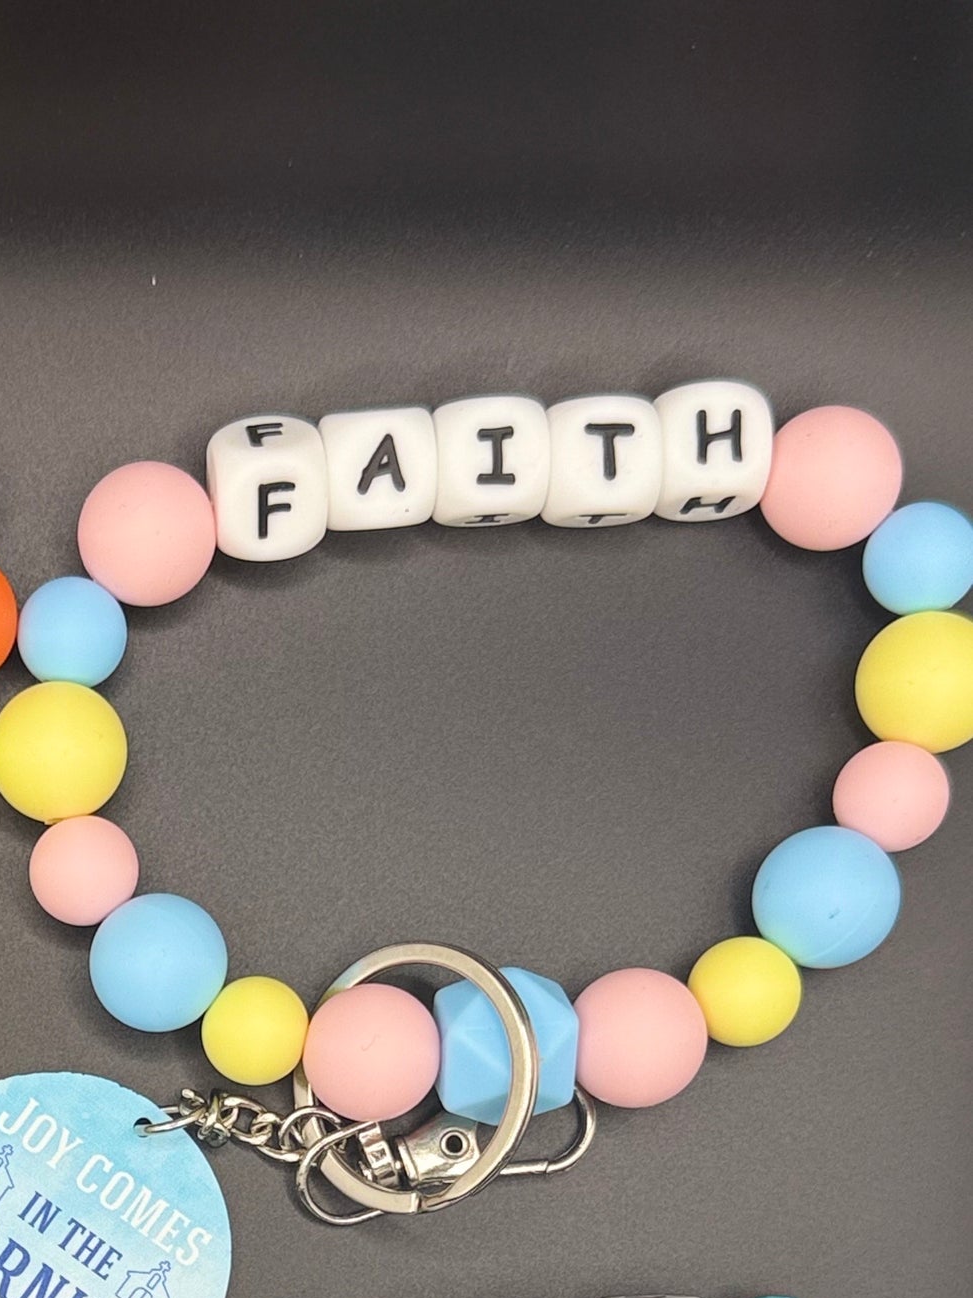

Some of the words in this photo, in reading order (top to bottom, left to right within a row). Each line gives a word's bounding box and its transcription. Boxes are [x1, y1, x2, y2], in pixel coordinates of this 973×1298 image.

[245, 422, 283, 448] F
[258, 408, 743, 540] FAITH
[17, 1191, 62, 1234] IN
[58, 1218, 123, 1280] THE
[76, 1154, 213, 1266] COMES
